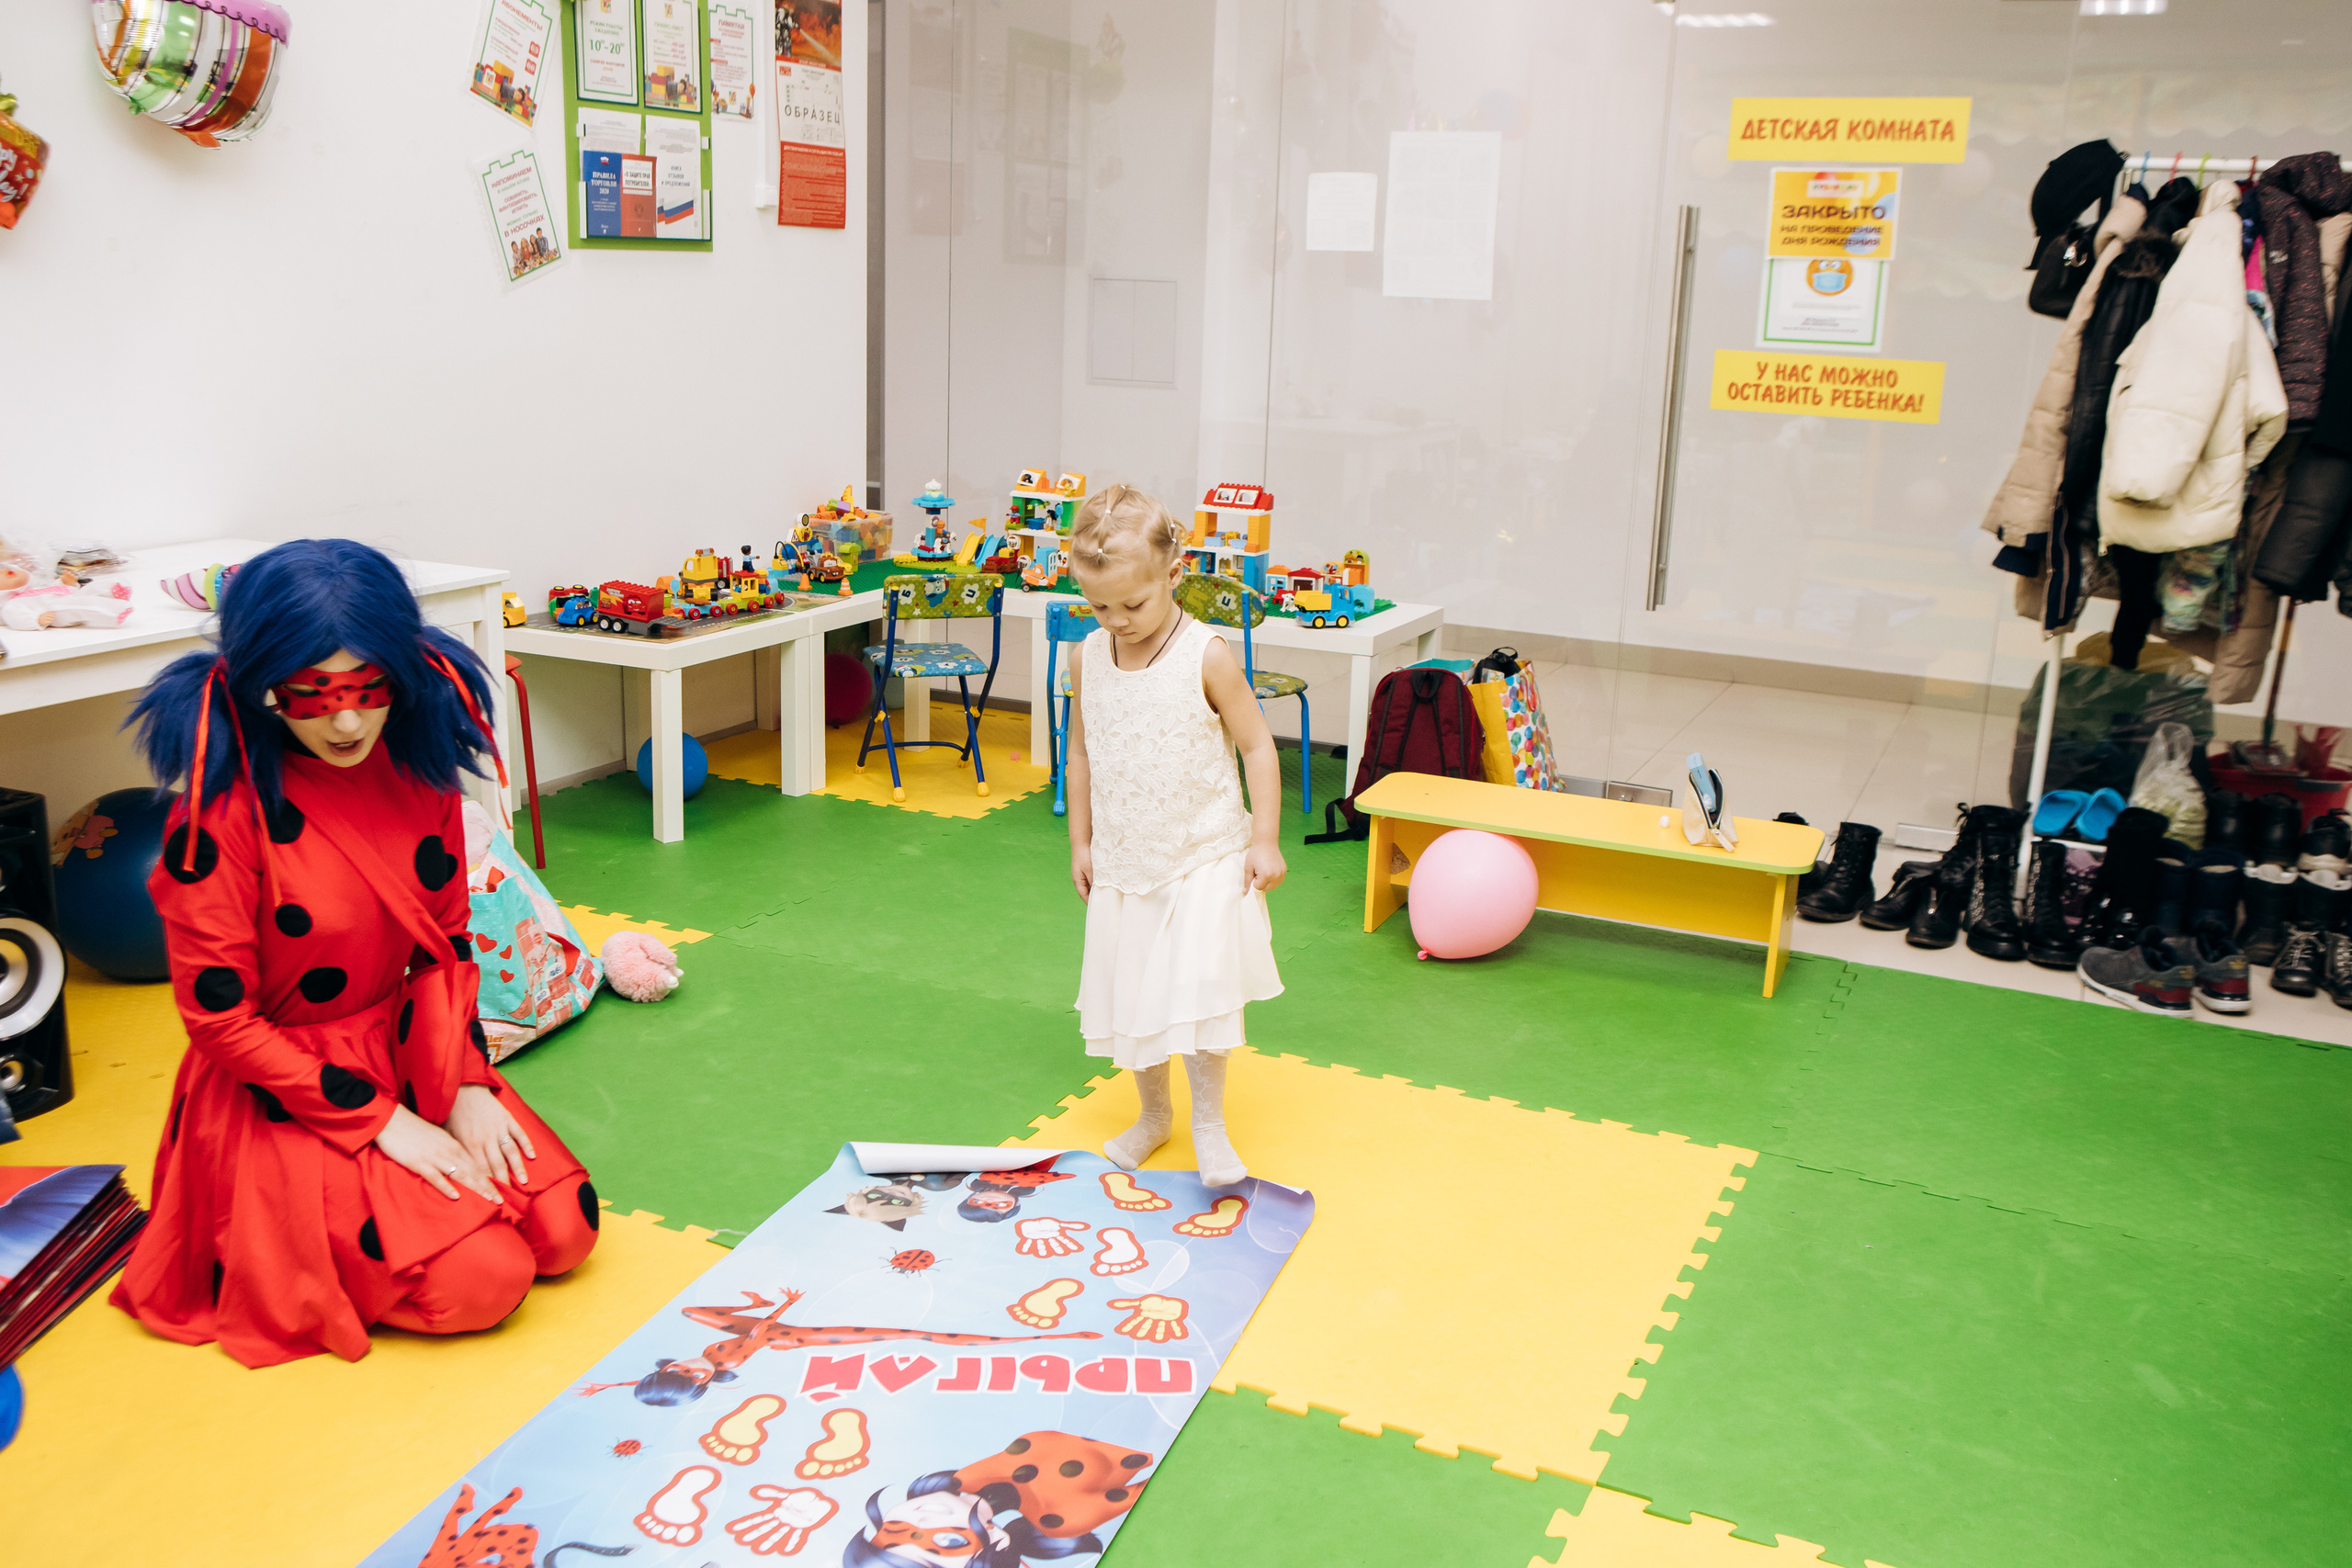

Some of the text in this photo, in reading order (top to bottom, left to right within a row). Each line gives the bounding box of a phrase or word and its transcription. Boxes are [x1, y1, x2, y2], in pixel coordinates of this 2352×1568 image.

[785, 104, 840, 125] ОБРАЗЕЦ
[1740, 118, 1956, 142] ДЕТСКАЯ КОМНАТА
[492, 166, 533, 188] НАПОМИНАЕМ
[1781, 205, 1886, 220] ЗАКРЫТО
[511, 214, 545, 235] НОСОЧКАХ
[1781, 224, 1883, 234] НА ПРОВЕДЕНИЕ
[1781, 237, 1881, 246] ДНЯ РОЖДЕНИЯ
[1757, 361, 1899, 388] У НАС МОЖНО
[1727, 381, 1925, 413] ОСТАВИТЬ РЕБЕНКА!
[797, 1352, 1195, 1404] ПРЫГАЙ
